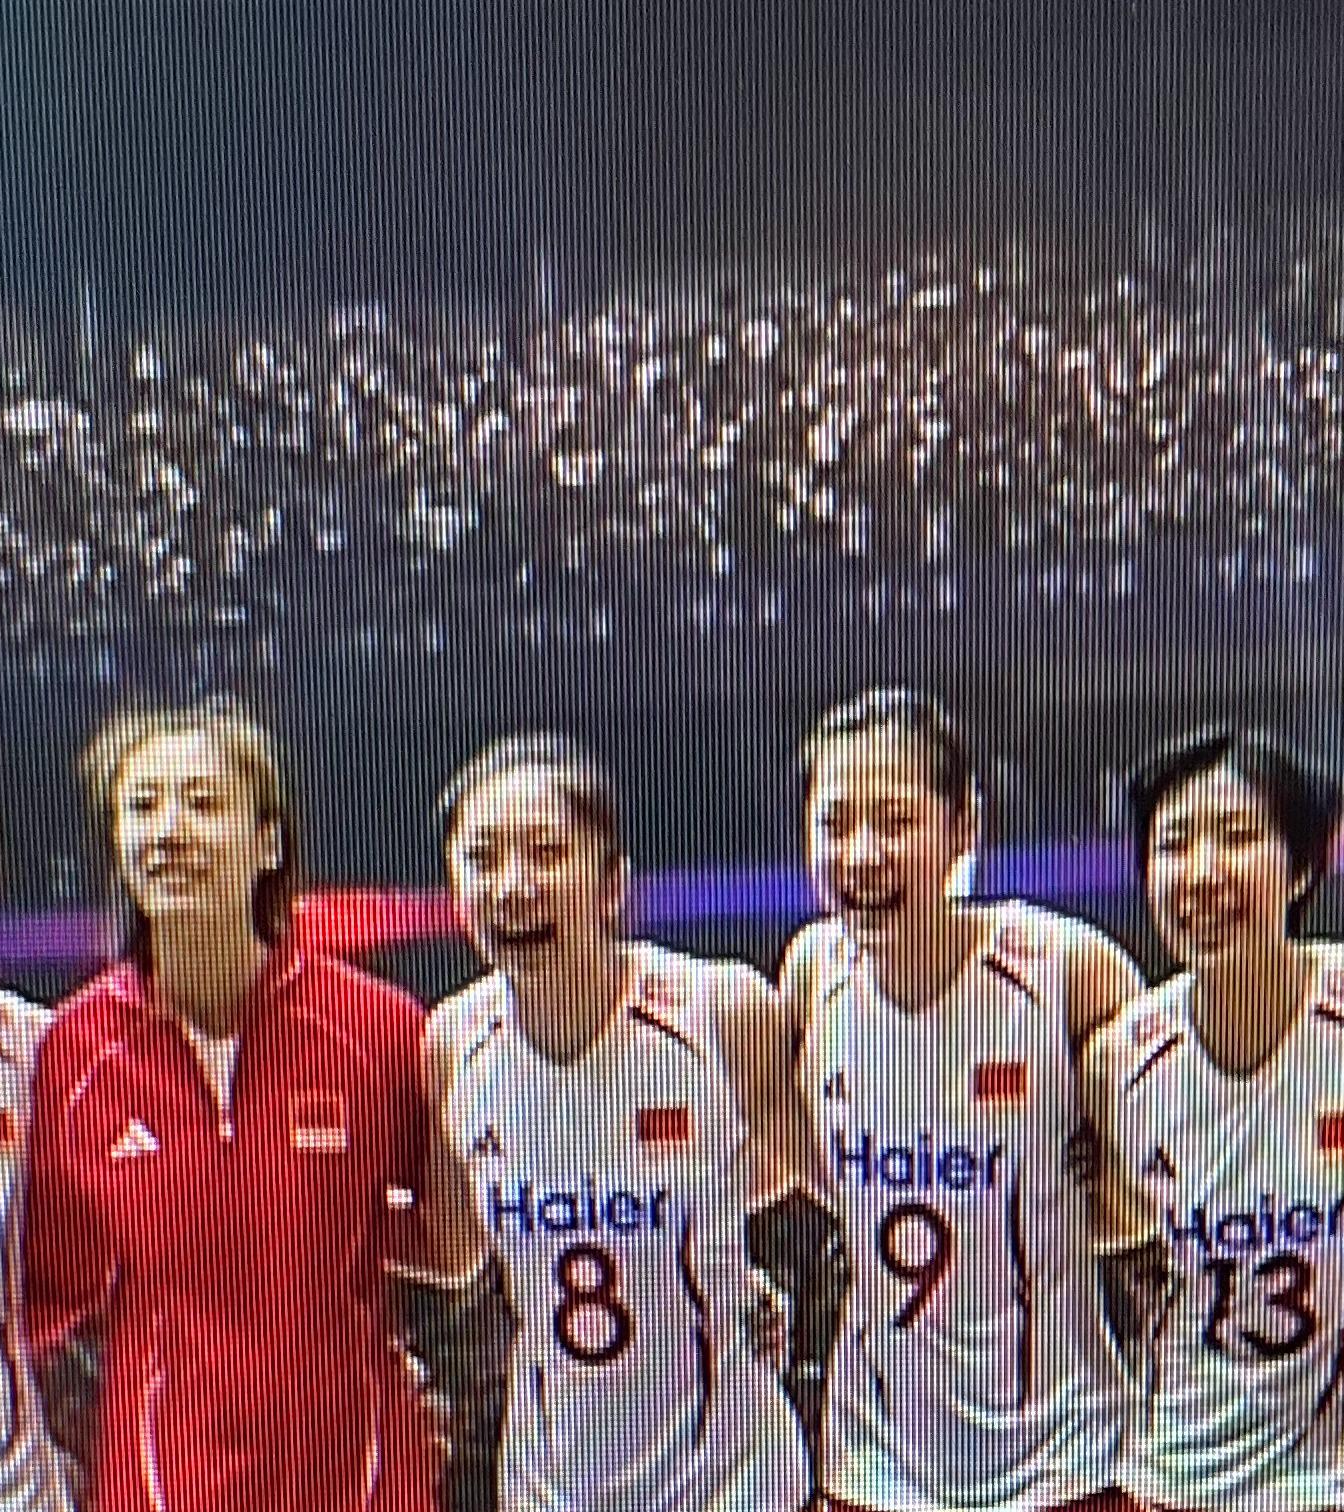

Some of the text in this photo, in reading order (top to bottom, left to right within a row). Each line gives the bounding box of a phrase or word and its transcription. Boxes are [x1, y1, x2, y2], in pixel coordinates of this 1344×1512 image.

[488, 1180, 667, 1234] Haier
[829, 1130, 1004, 1194] Haier
[556, 1244, 632, 1366] 8
[879, 1202, 952, 1329] 9
[1203, 1252, 1318, 1357] 13
